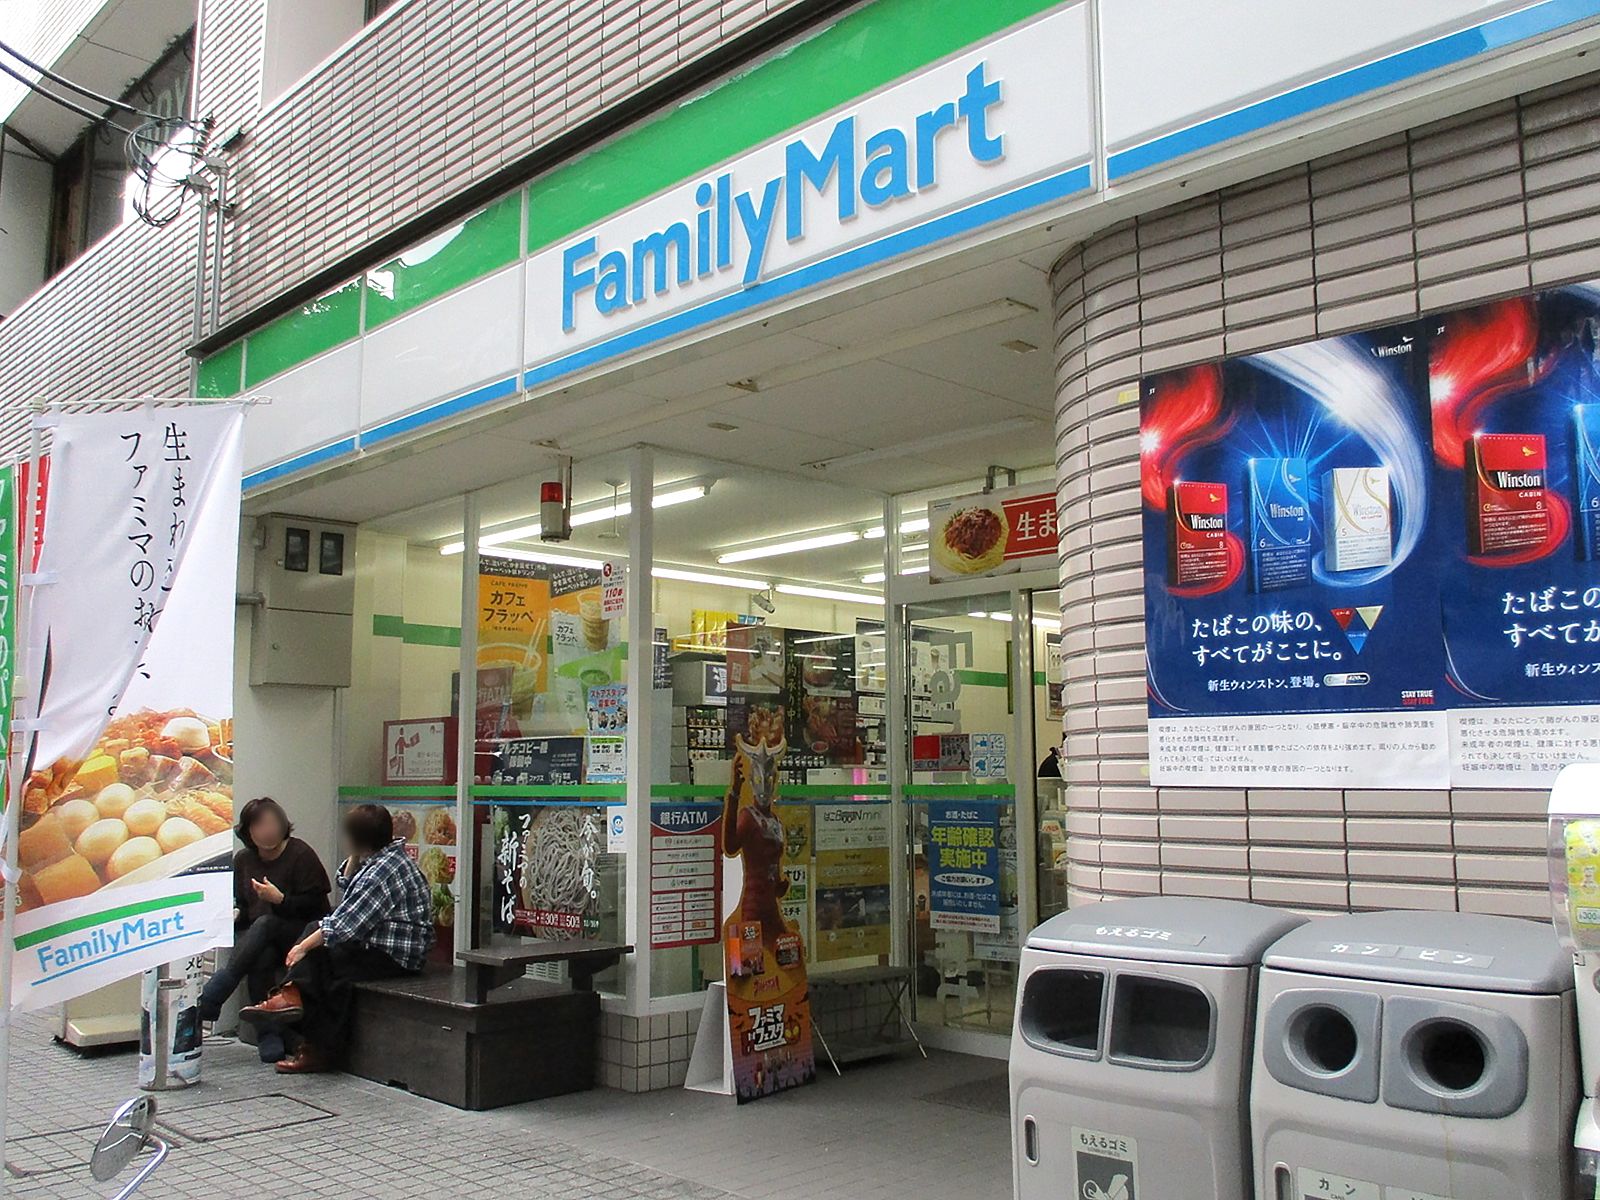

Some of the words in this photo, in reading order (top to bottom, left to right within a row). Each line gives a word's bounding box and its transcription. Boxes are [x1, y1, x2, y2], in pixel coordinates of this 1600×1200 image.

[562, 61, 1004, 333] FamilyMart
[1378, 344, 1412, 357] Winston
[1497, 472, 1541, 488] Winston
[1270, 503, 1304, 519] Winston
[1191, 514, 1223, 530] Winston
[1259, 538, 1266, 548] 6
[490, 590, 526, 607] カフェ
[1502, 586, 1600, 614] たばこの
[483, 608, 534, 624] フラッペ
[1192, 611, 1322, 639] たばこの味の、
[557, 626, 574, 635] カフェ
[1192, 641, 1342, 667] すべてがここに。
[1207, 675, 1320, 692] 新生ウィンストン、登場。
[1416, 690, 1433, 698] TRUE
[660, 811, 708, 825] 銀行ATM
[931, 827, 996, 848] 年齢確認
[940, 848, 987, 869] 実施中
[497, 830, 519, 924] 新そば
[36, 911, 185, 973] FamilyMart
[1095, 925, 1173, 941] もえるゴミ
[748, 1003, 785, 1030] ファミマ
[755, 1022, 785, 1044] フェスタ
[1080, 1133, 1128, 1153] もえるゴミ
[1319, 1177, 1356, 1196] カン
